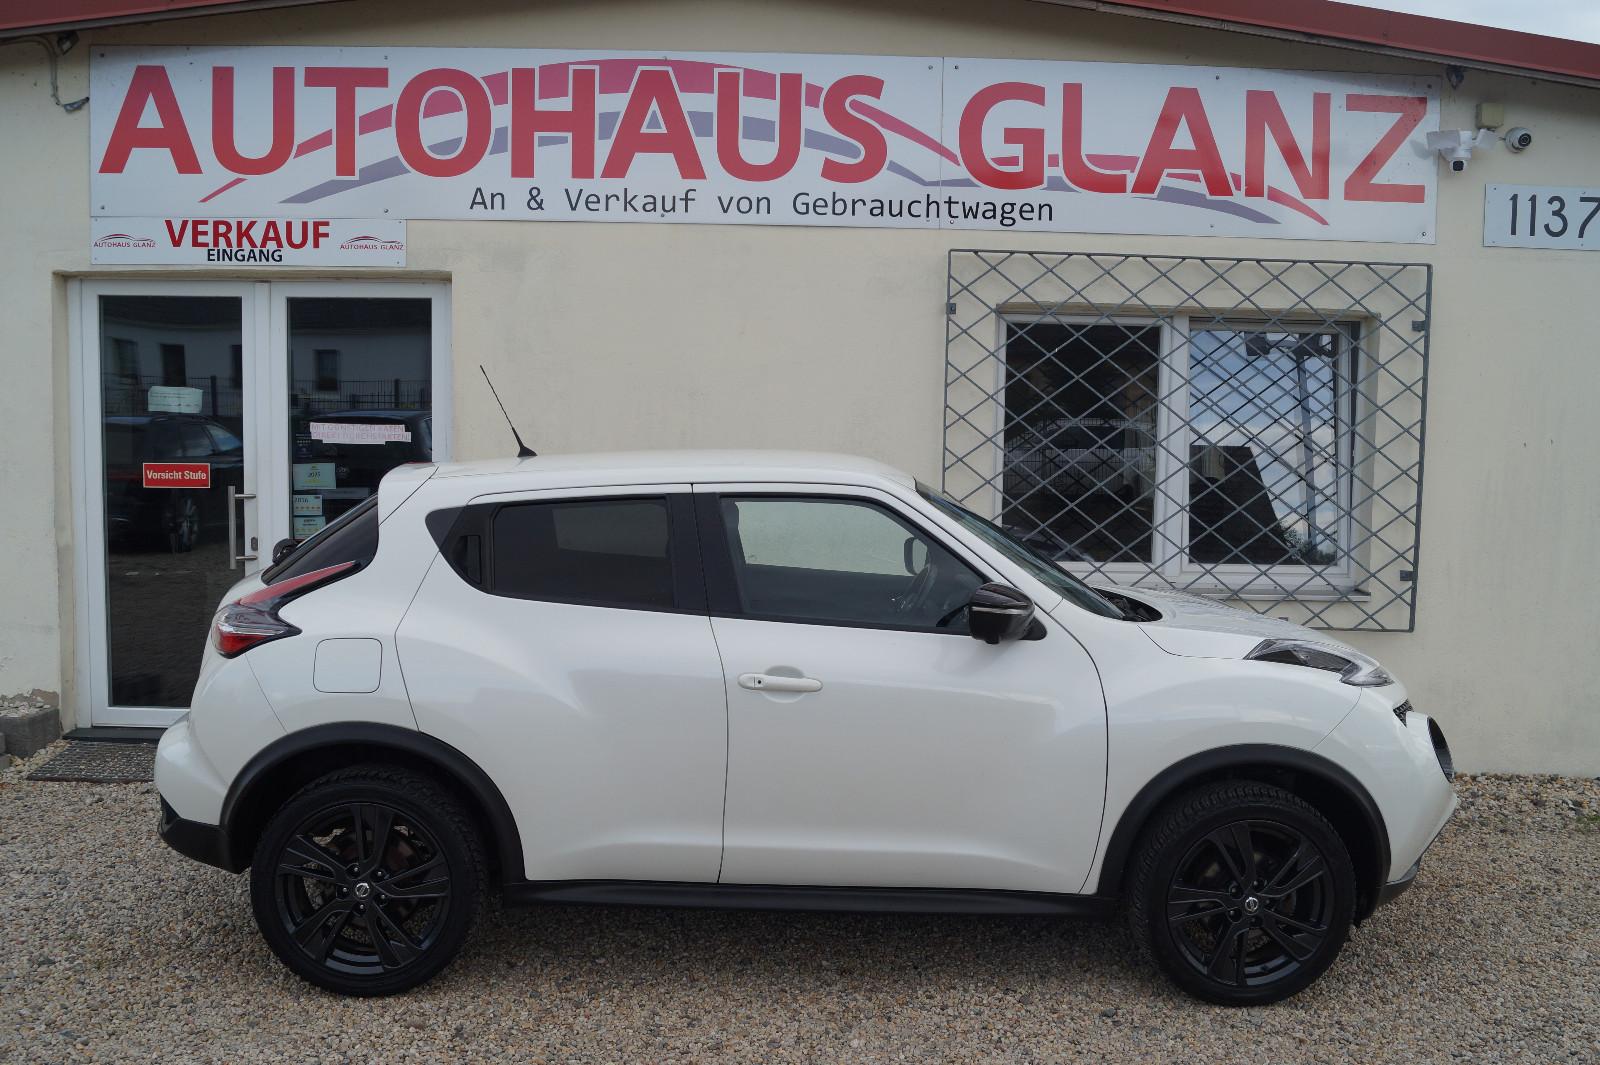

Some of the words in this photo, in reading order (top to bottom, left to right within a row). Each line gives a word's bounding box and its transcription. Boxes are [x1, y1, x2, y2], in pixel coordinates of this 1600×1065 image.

[98, 64, 888, 183] AUTOHAUS
[958, 81, 1428, 204] GLANZ
[469, 187, 505, 210] An
[526, 186, 545, 211] &
[564, 187, 697, 213] Verkauf
[717, 195, 771, 215] von
[792, 191, 1053, 227] Gebrauchtwagen
[1509, 193, 1600, 239] 1137
[164, 219, 330, 249] VERKAUF
[207, 248, 283, 263] EINGANG
[146, 470, 182, 480] Vorsicht
[183, 470, 207, 480] Stufe
